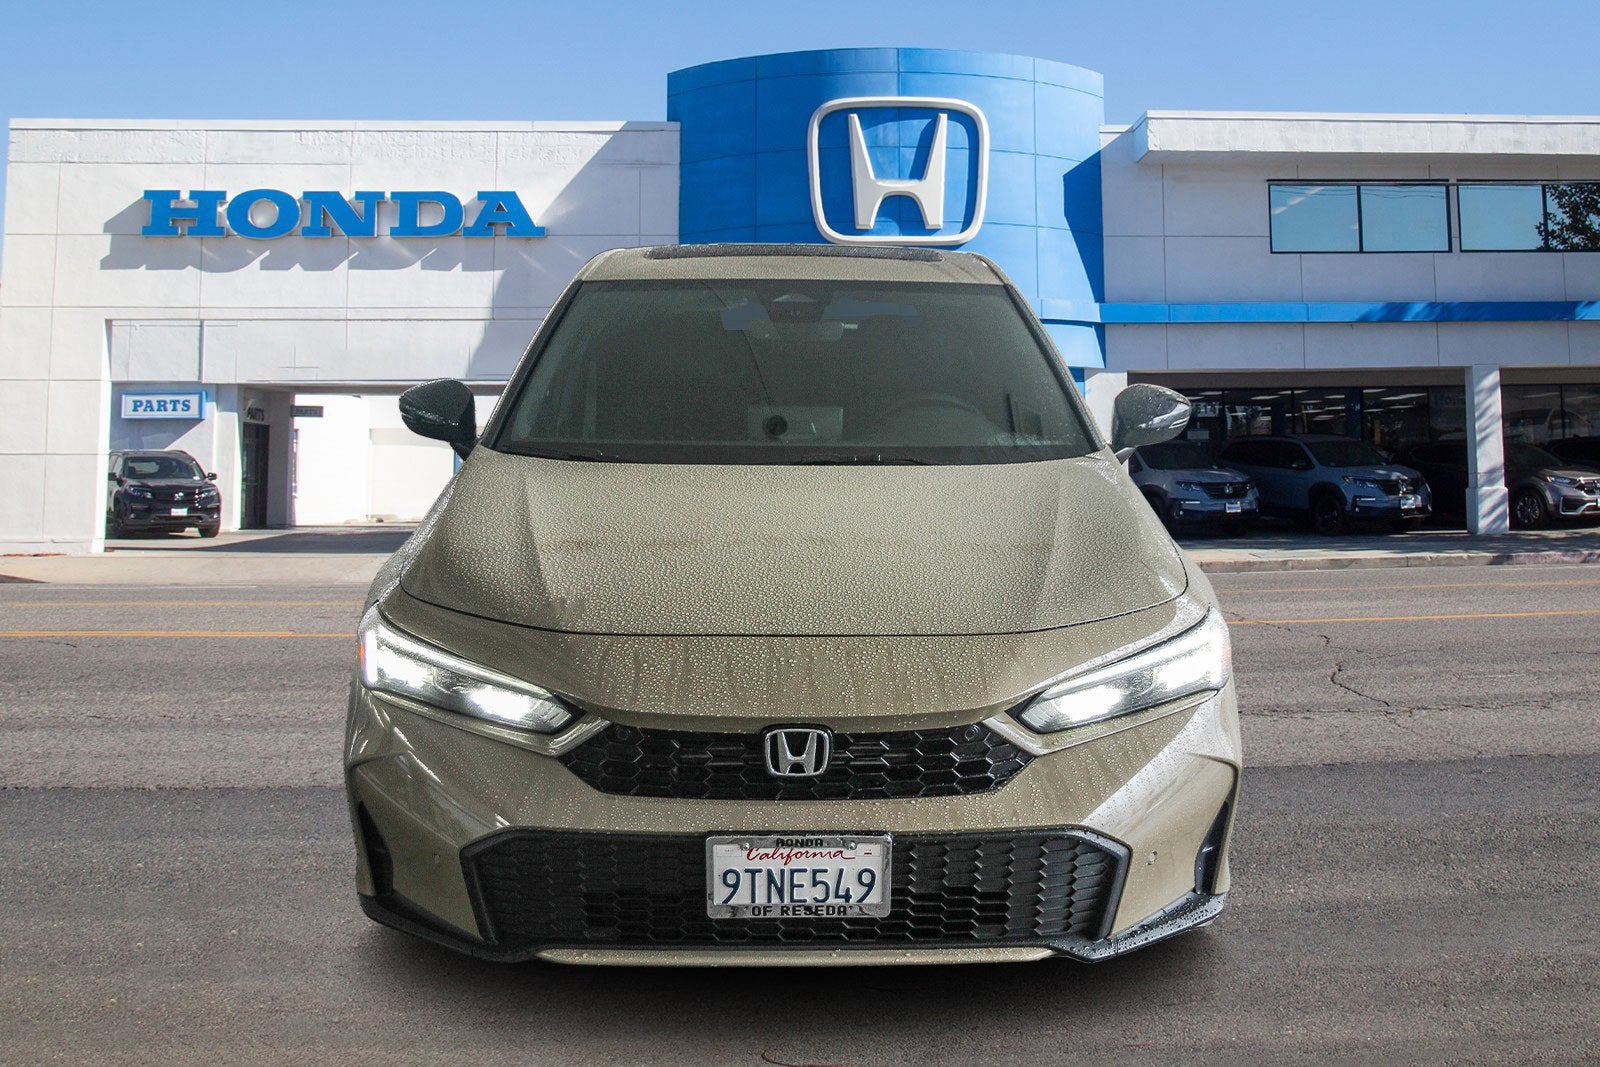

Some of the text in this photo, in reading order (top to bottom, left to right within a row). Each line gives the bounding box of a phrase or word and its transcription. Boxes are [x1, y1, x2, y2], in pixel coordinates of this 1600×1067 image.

[141, 189, 546, 238] HONDA
[132, 400, 191, 412] PARTS
[746, 847, 856, 866] California
[721, 867, 877, 904] 9TNE549
[751, 905, 848, 917] OF RESEDA
